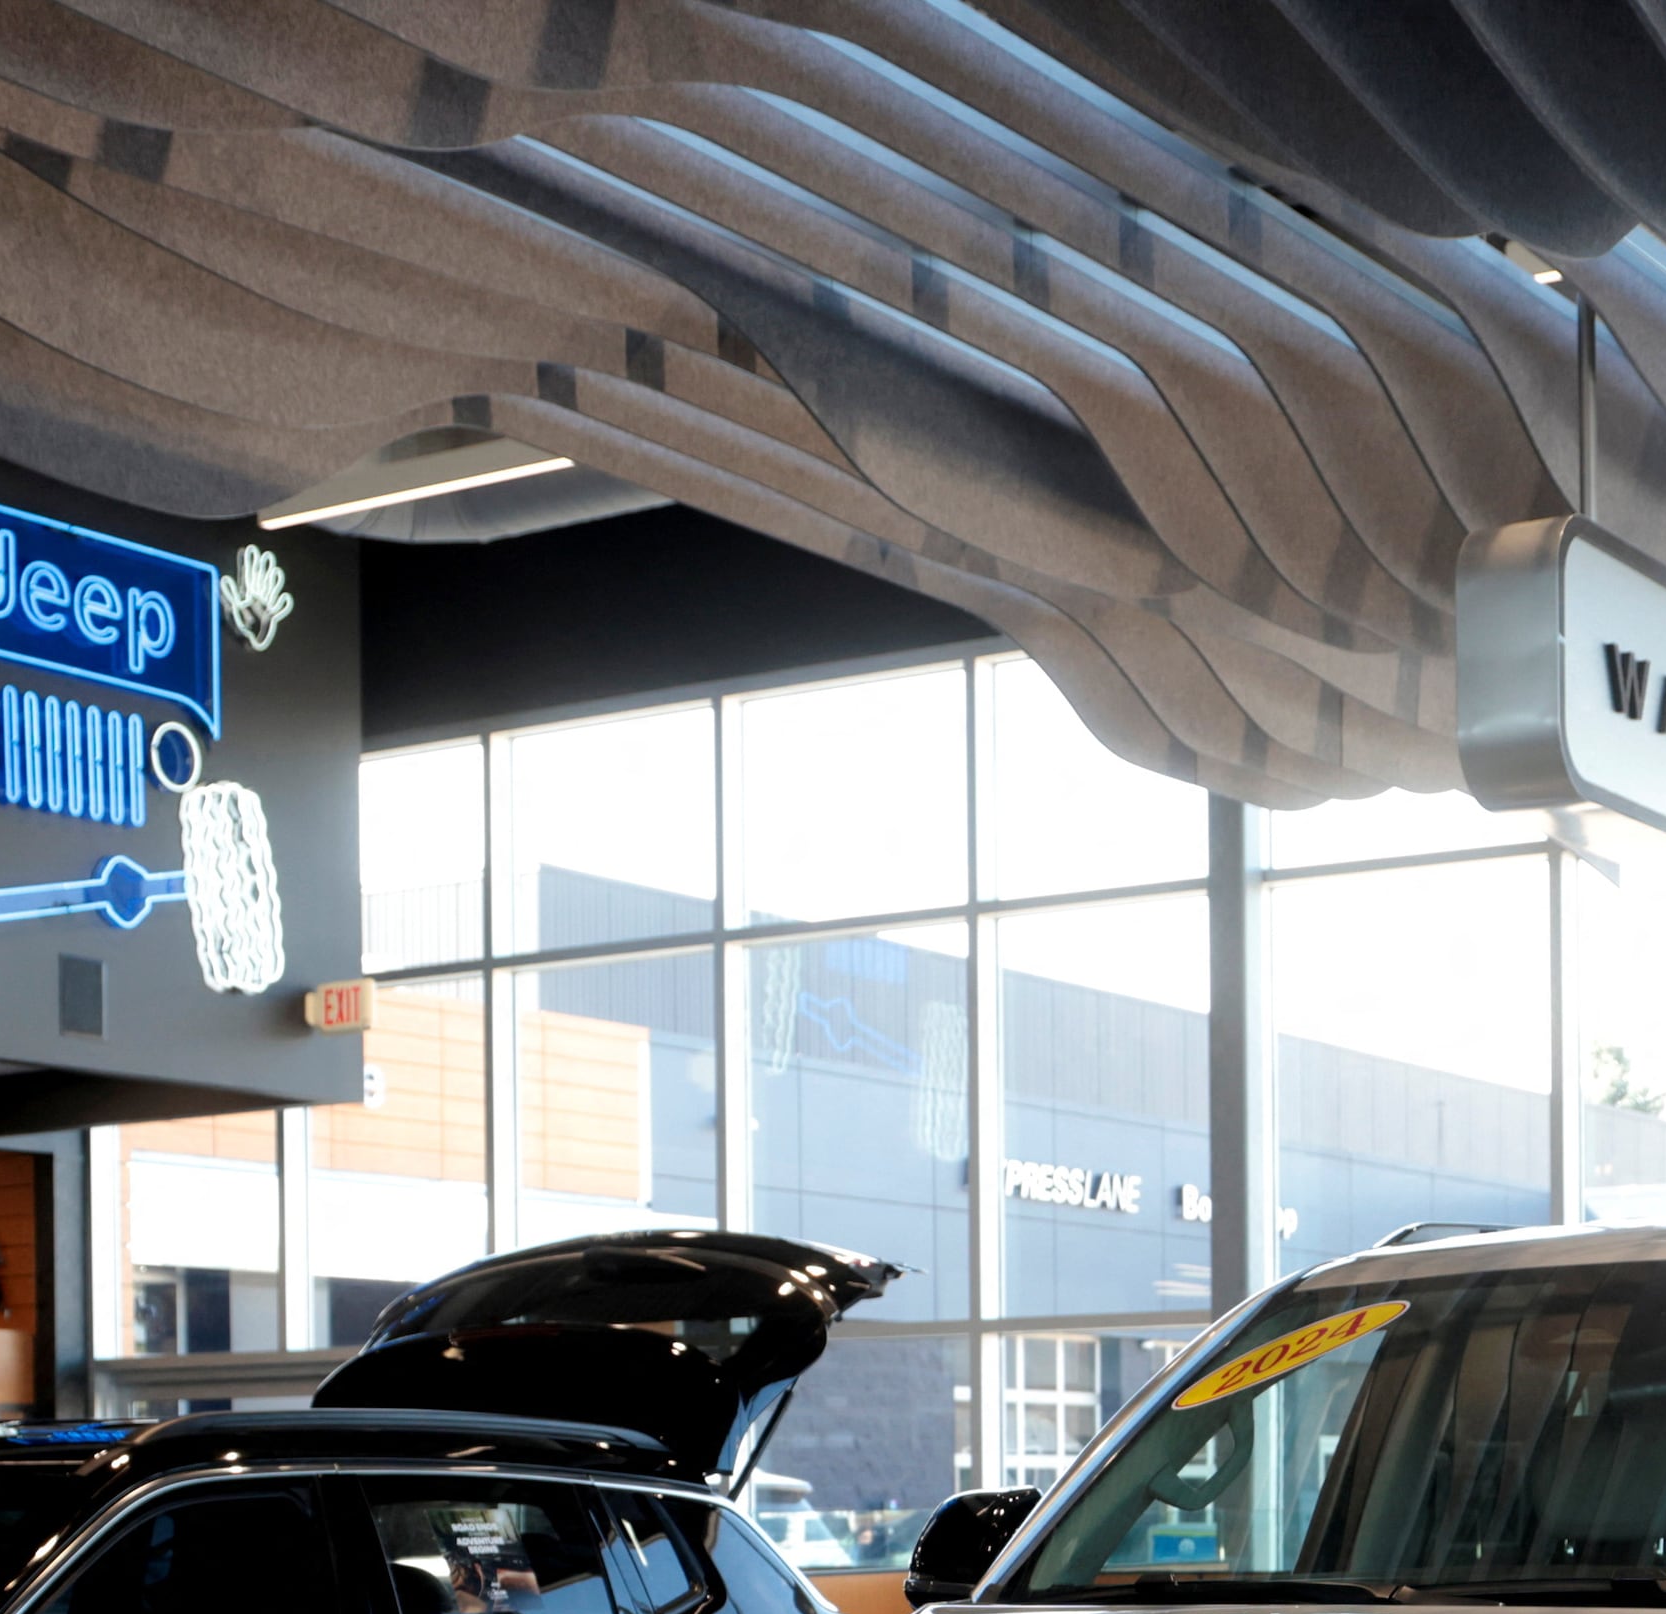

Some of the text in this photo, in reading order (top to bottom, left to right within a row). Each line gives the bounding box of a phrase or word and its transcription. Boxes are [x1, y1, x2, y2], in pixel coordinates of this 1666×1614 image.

[323, 985, 361, 1025] EXIT
[1182, 1184, 1213, 1222] Bo
[1212, 1311, 1368, 1396] 2024
